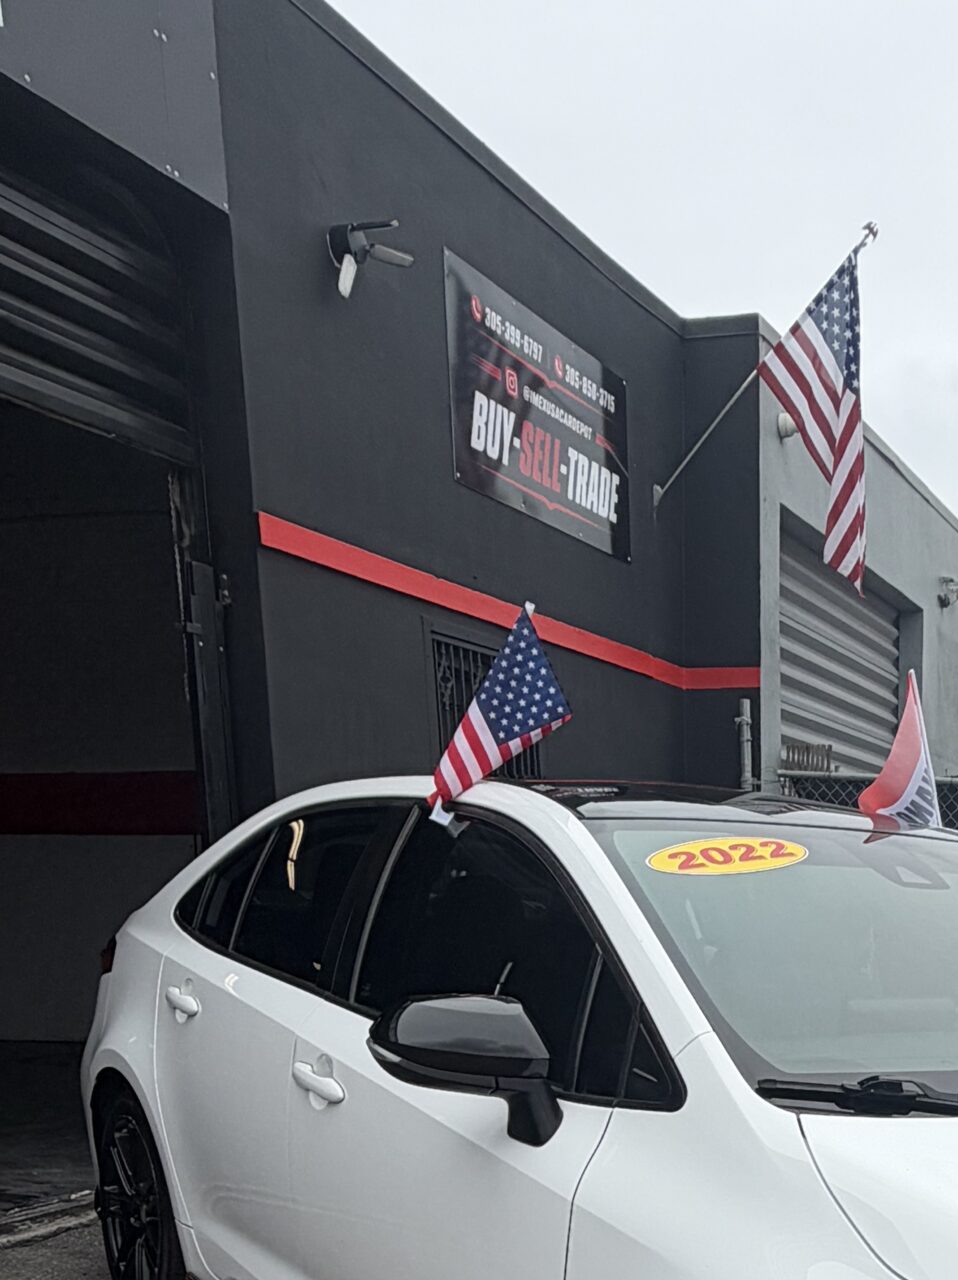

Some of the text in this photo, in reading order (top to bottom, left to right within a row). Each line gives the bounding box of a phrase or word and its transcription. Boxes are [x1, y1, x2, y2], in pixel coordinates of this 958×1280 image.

[485, 307, 543, 363] 305-399-6797
[470, 390, 620, 524] BUY-SELL-TRADE
[667, 840, 797, 870] 2022
